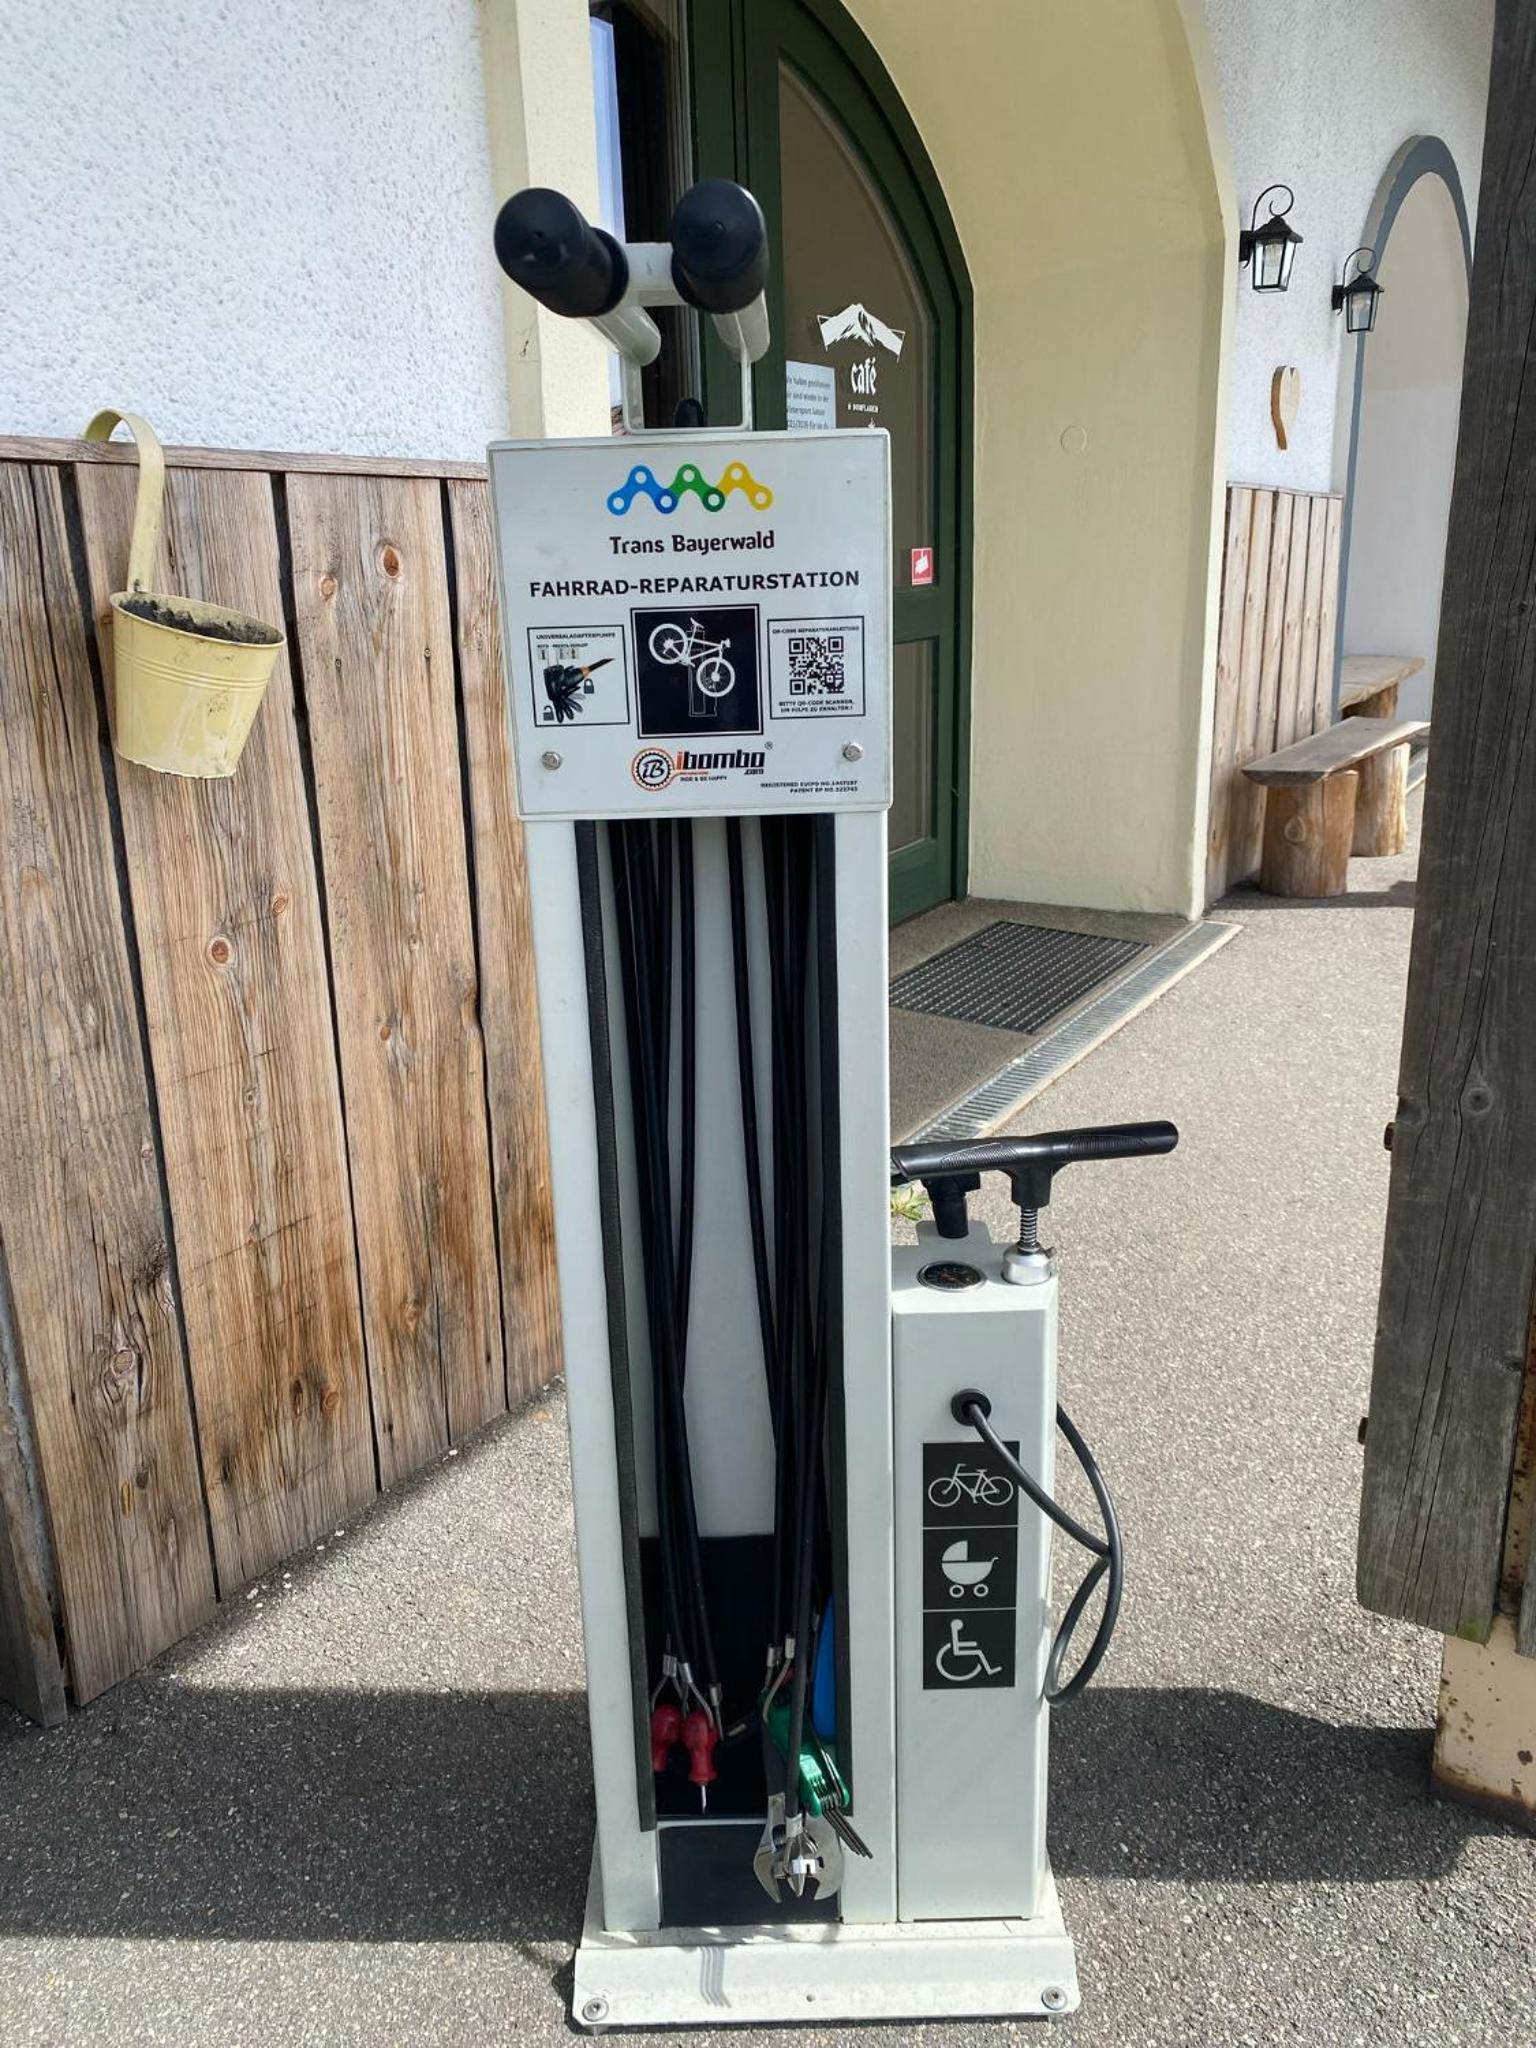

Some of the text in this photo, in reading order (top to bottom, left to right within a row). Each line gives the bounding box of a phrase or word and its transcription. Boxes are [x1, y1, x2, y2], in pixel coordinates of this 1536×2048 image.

[851, 357, 877, 396] café
[609, 530, 775, 556] Trans Bayerwald
[529, 570, 860, 598] FAHRRAD-REPARATURSTATION
[676, 749, 765, 771] ibombo
